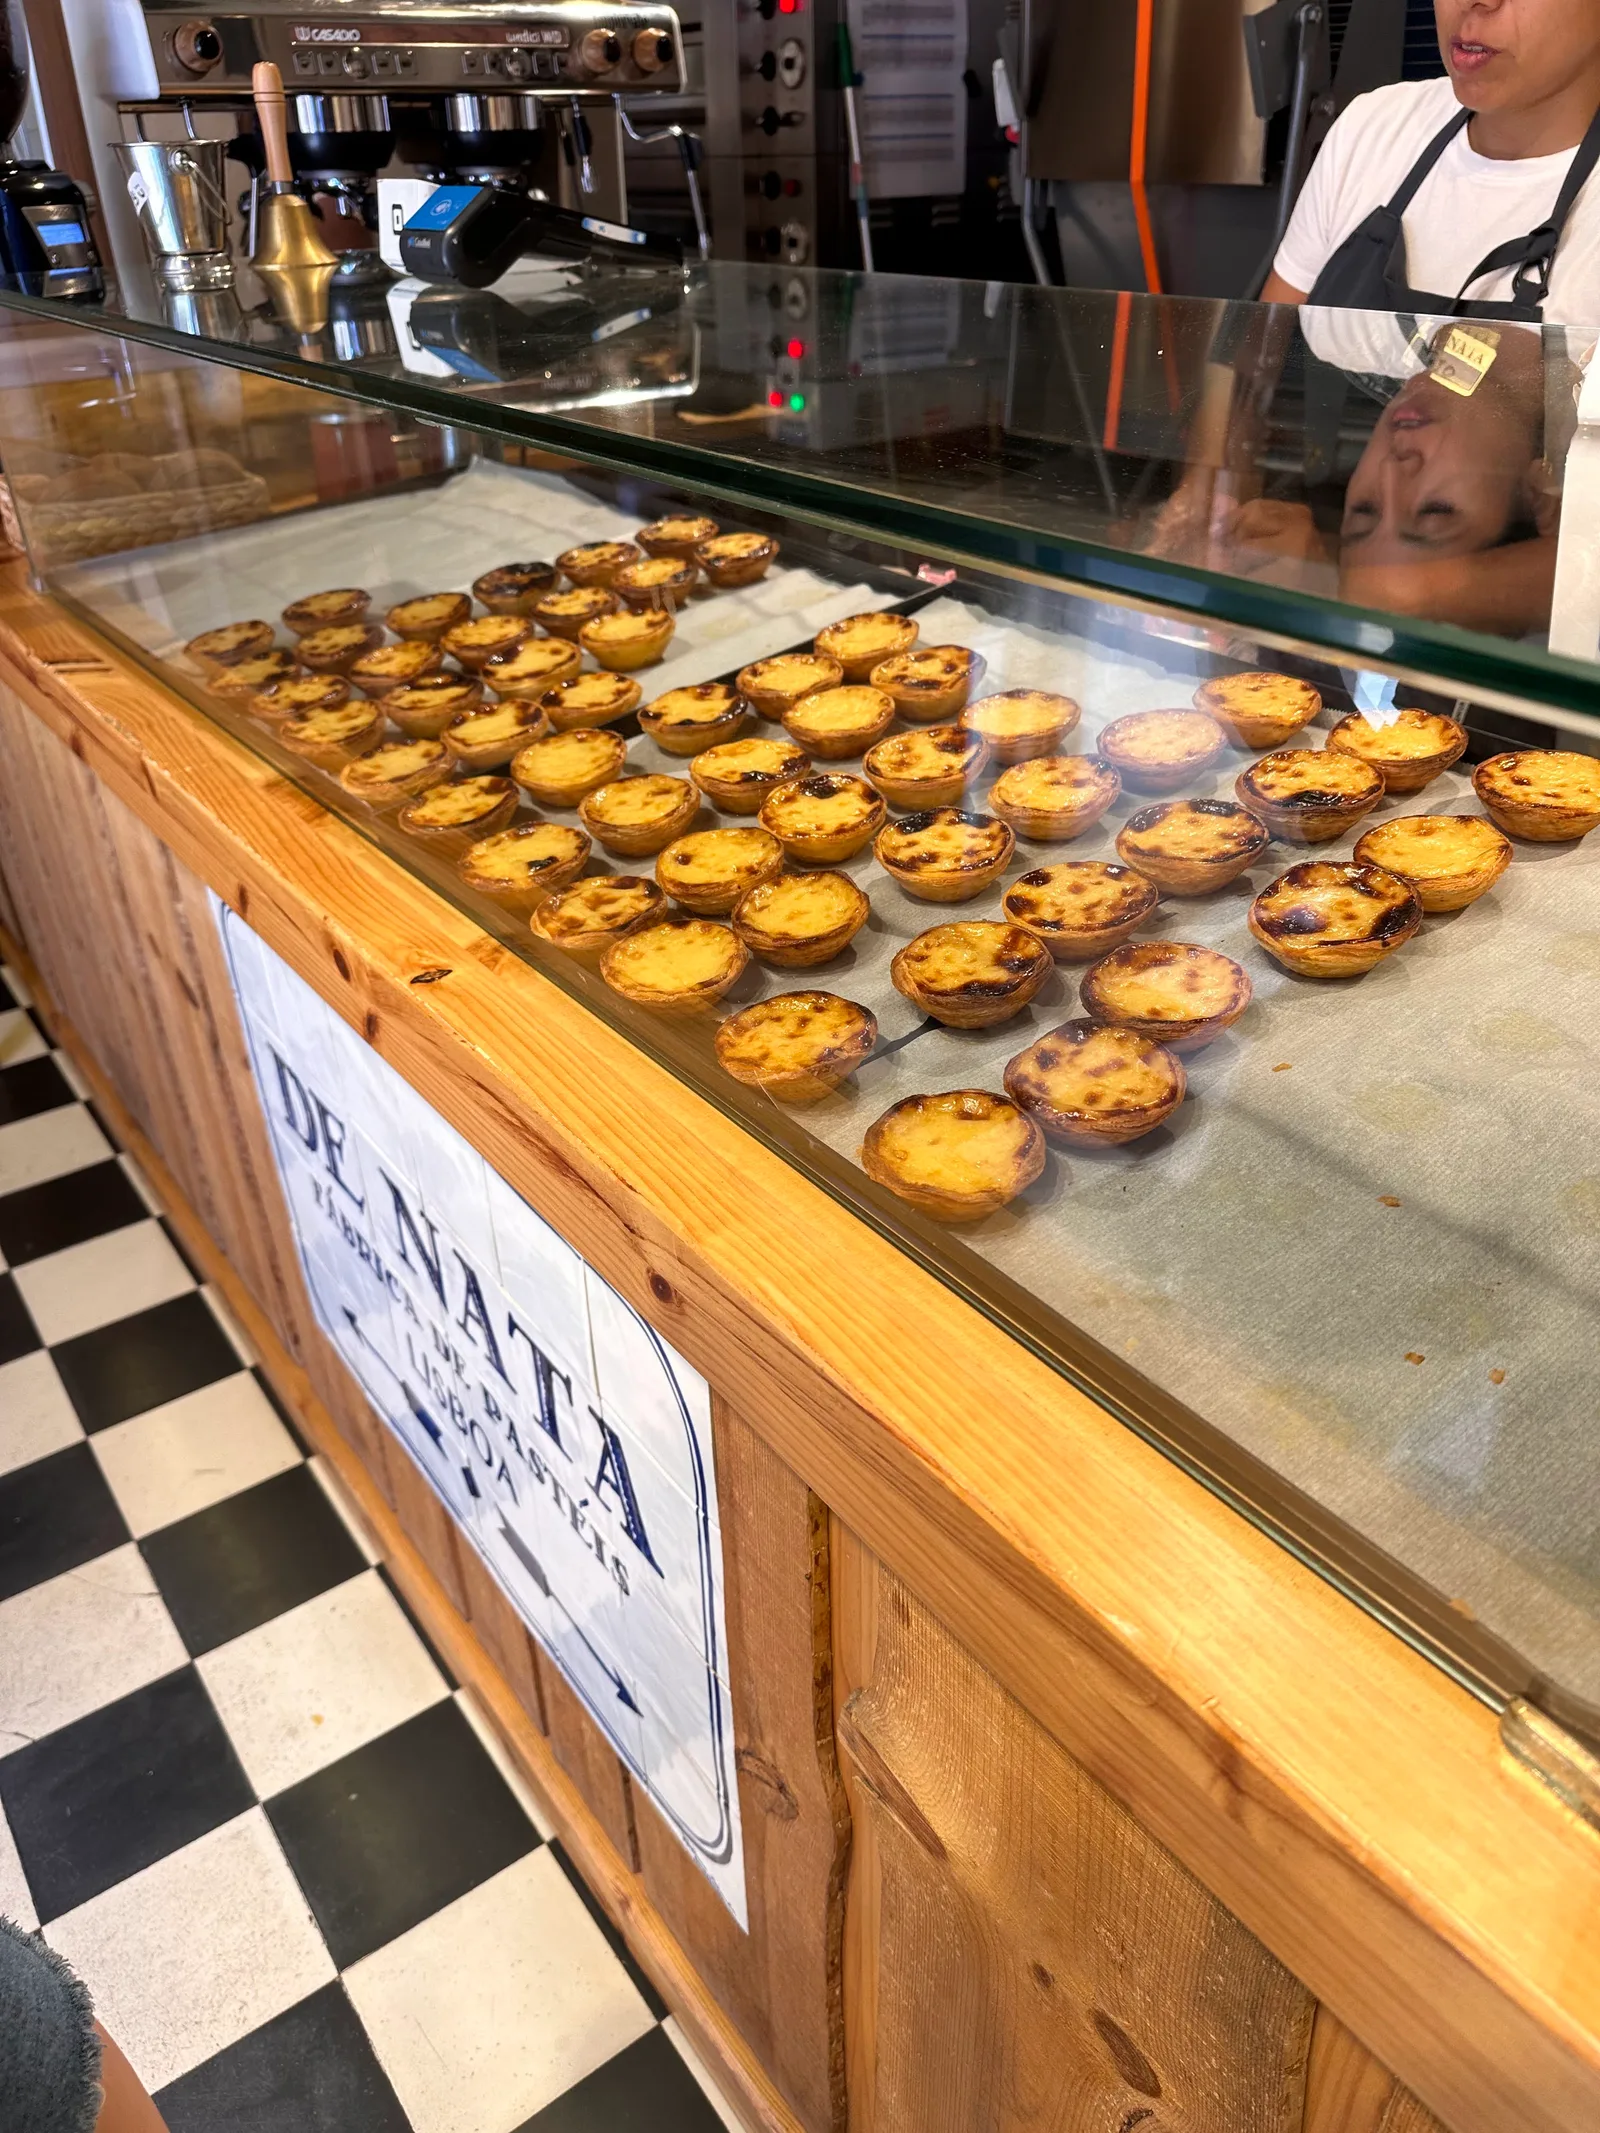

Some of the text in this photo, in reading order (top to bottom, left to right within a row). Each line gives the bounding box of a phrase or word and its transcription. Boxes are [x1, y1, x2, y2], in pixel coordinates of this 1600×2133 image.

[311, 28, 361, 41] CASADIO
[269, 1042, 665, 1580] DE NATA
[312, 1179, 631, 1597] FÁBRICA DE PASTÉIS
[406, 1332, 521, 1506] LISBOA
